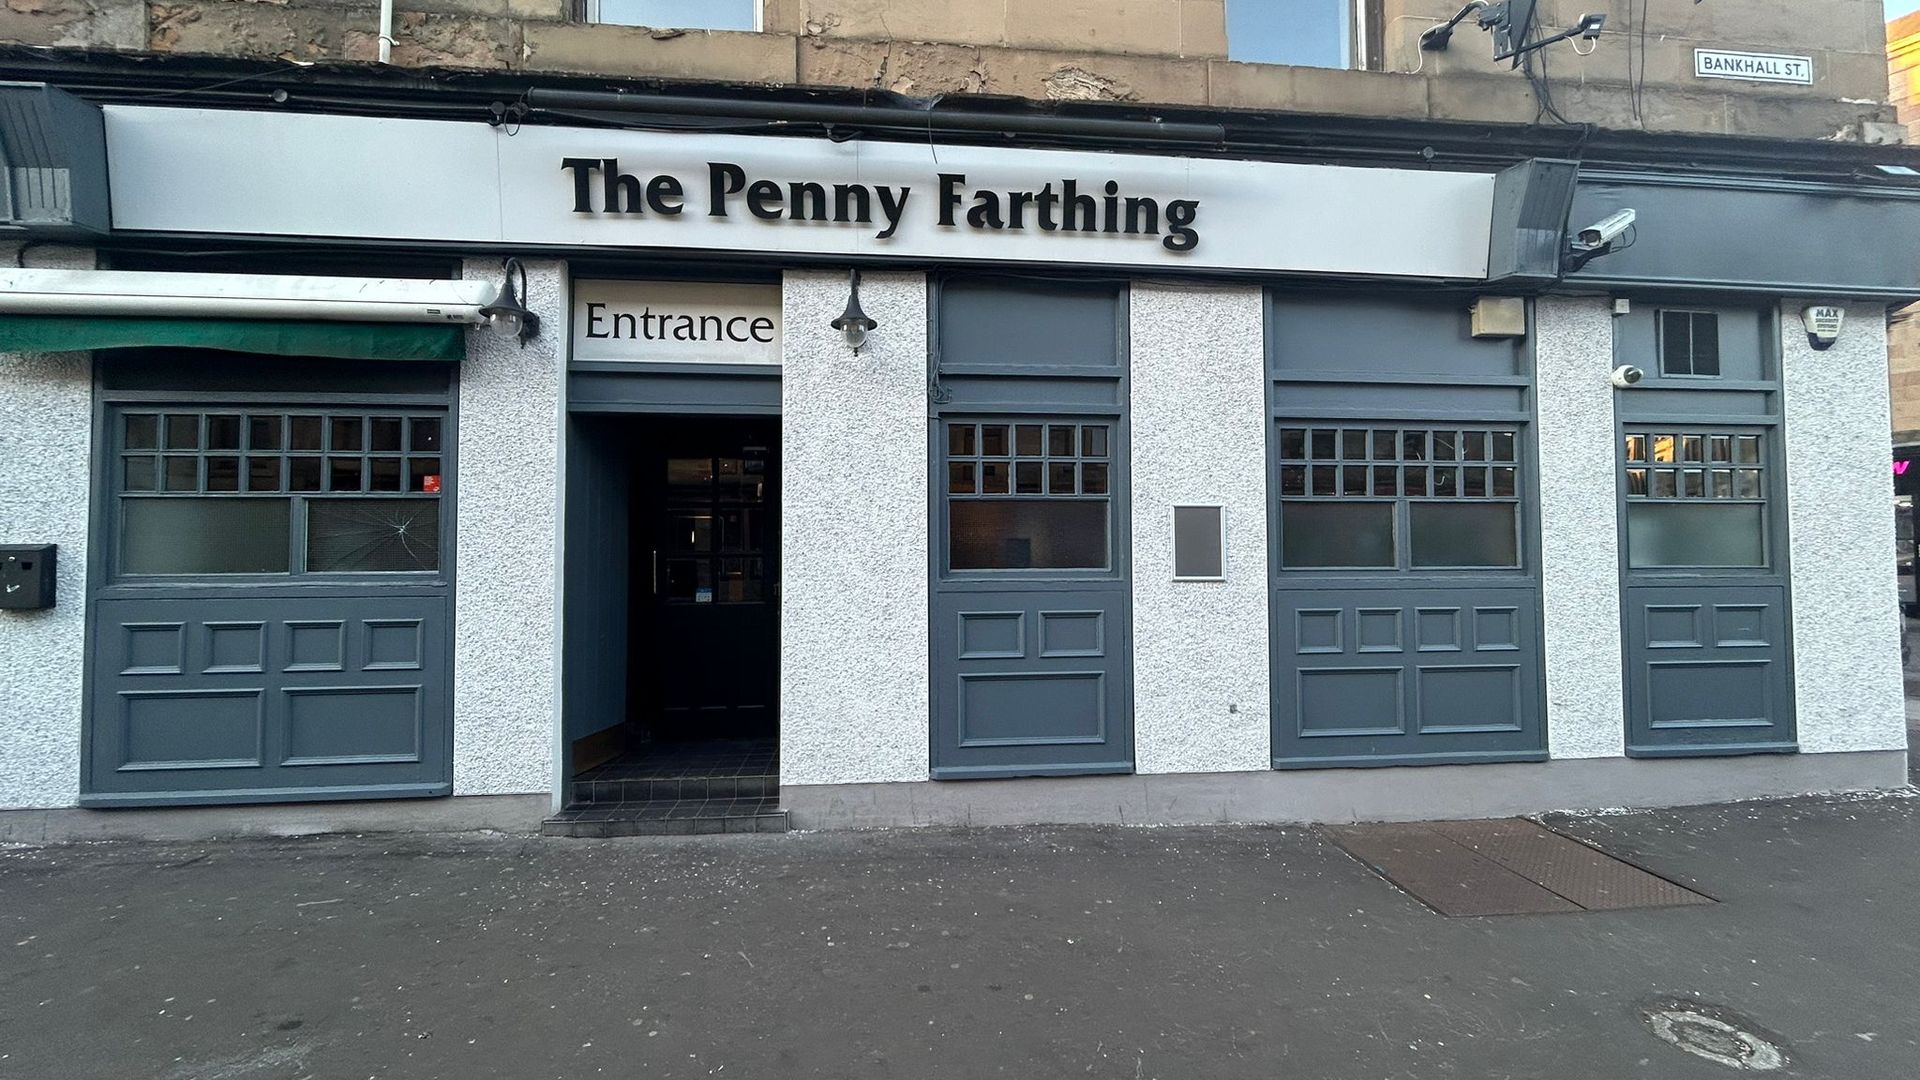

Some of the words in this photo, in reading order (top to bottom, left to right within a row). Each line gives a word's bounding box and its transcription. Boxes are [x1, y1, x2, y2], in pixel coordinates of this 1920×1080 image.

[1704, 57, 1780, 74] BANKHALL
[1785, 63, 1804, 77] ST.
[561, 157, 684, 216] The
[706, 161, 911, 239] Penny
[937, 173, 1200, 251] Farthing
[585, 302, 775, 343] Entrance
[1816, 309, 1838, 317] MAX
